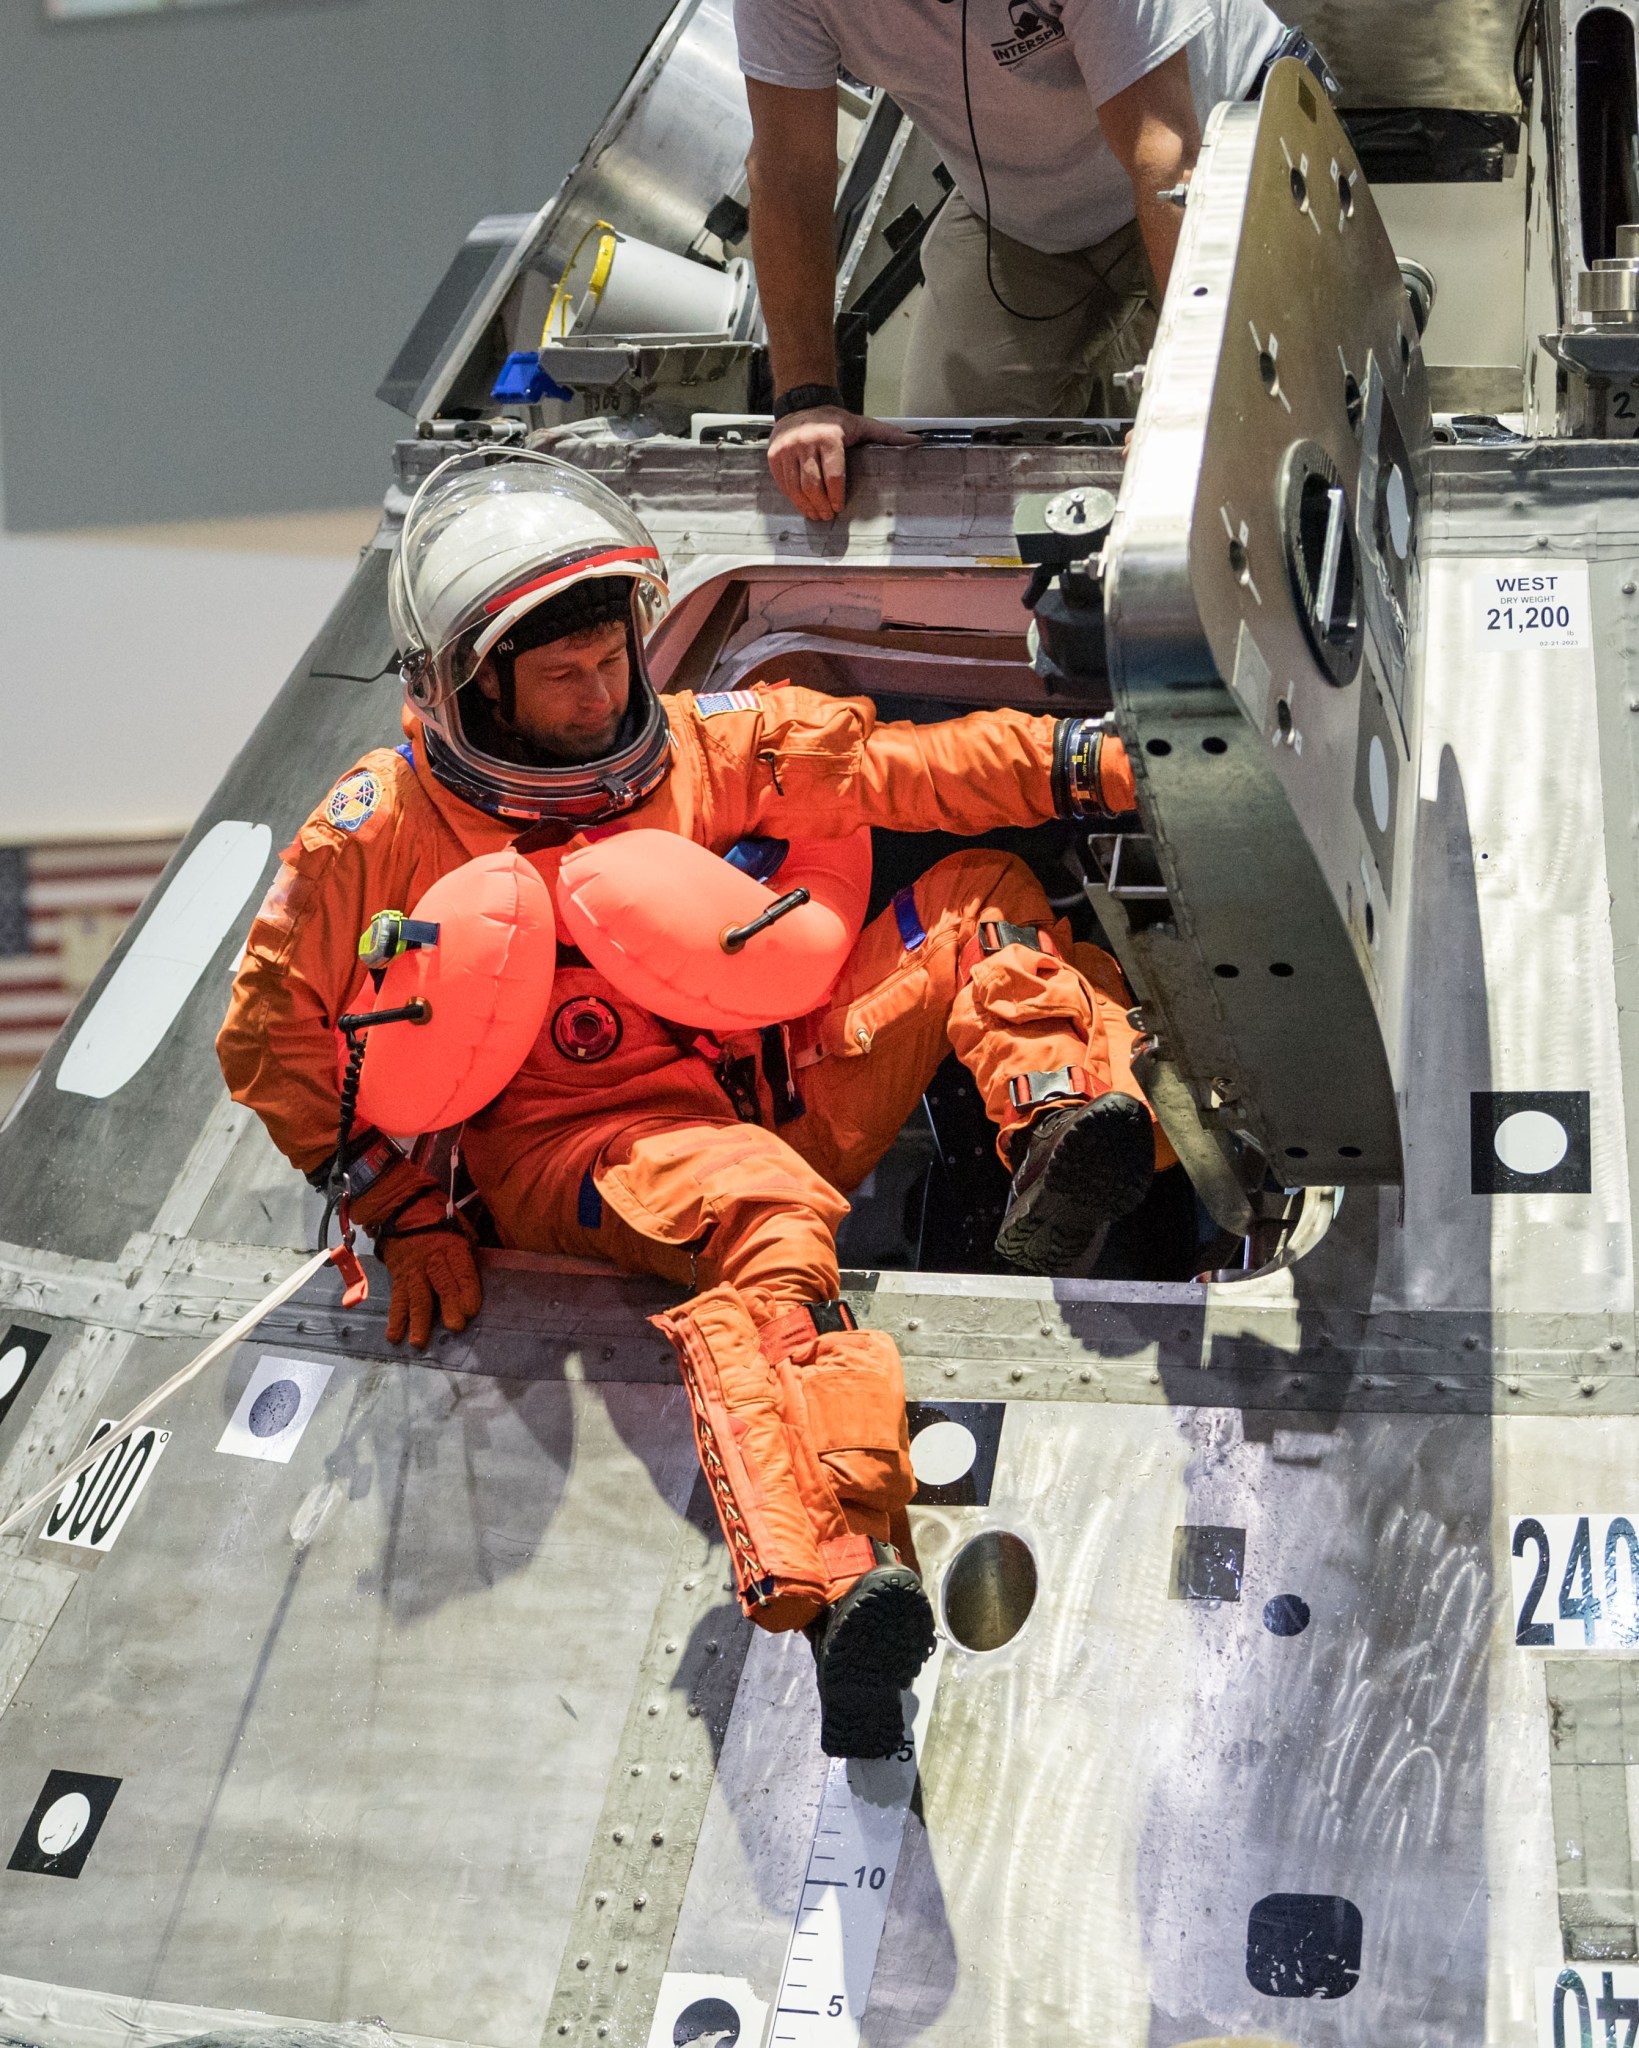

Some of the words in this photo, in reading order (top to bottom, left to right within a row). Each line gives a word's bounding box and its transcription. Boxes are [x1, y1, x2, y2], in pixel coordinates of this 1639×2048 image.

[1613, 391, 1636, 418] 2
[1496, 576, 1558, 592] WEST
[1521, 595, 1555, 603] WEIGHT
[1487, 606, 1569, 633] 21,200
[1512, 1517, 1639, 1646] 240
[854, 1866, 886, 1890] 10
[827, 1995, 844, 2017] 5
